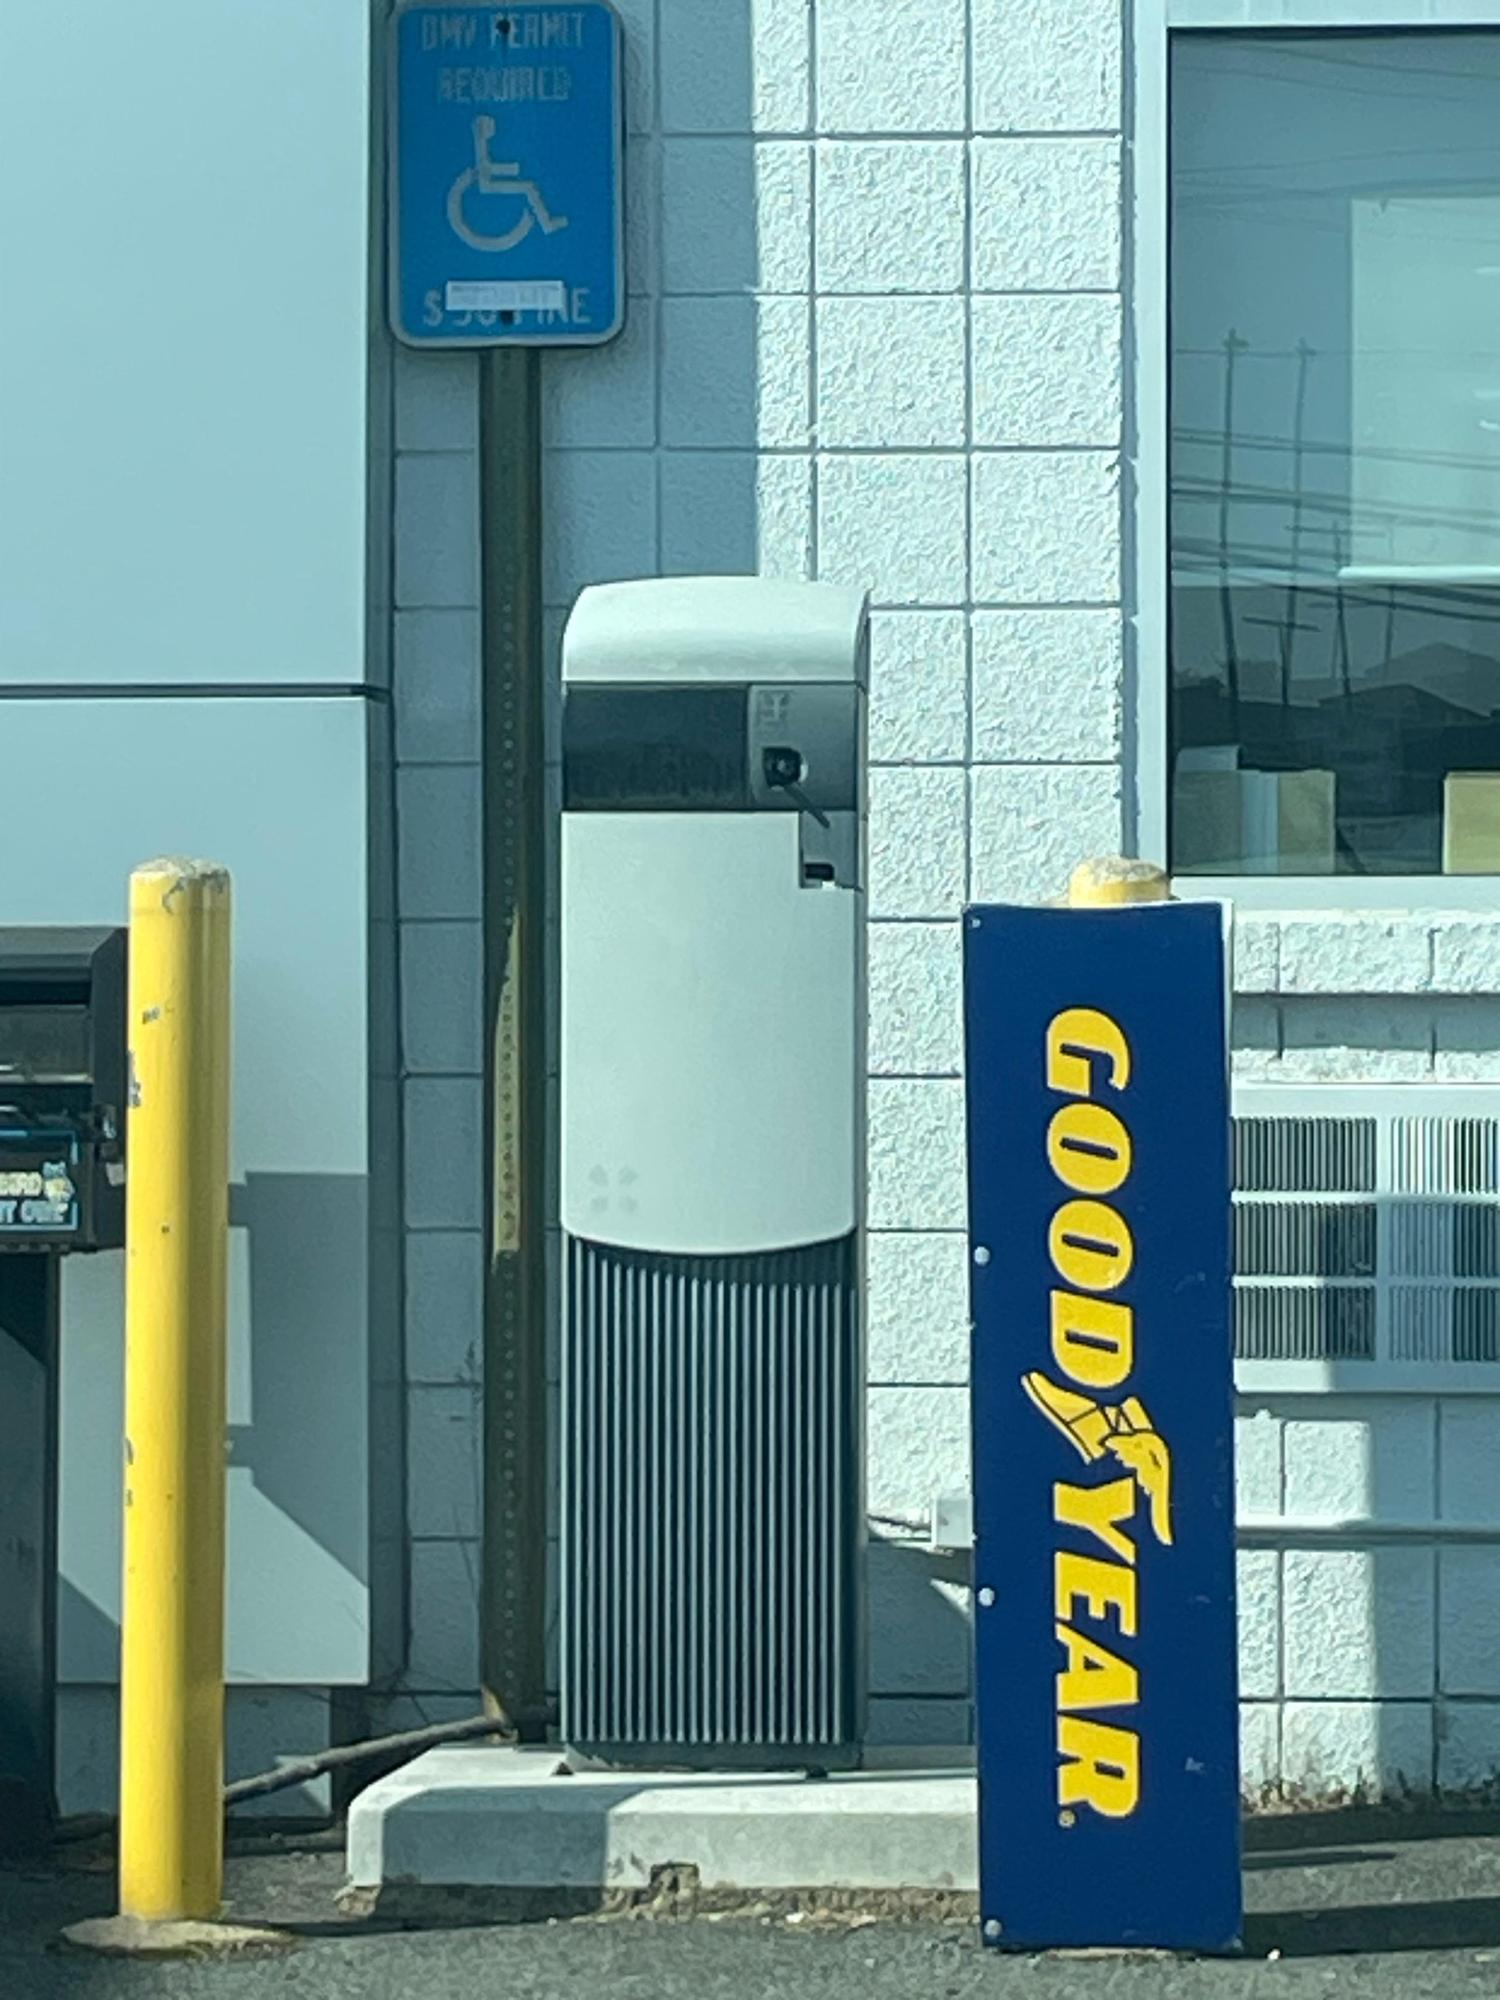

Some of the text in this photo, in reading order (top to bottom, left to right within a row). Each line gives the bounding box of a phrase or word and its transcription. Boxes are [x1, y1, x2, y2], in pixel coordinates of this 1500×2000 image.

[421, 12, 585, 50] DMV PERMIT
[1046, 1007, 1140, 1818] GOODYEAR
